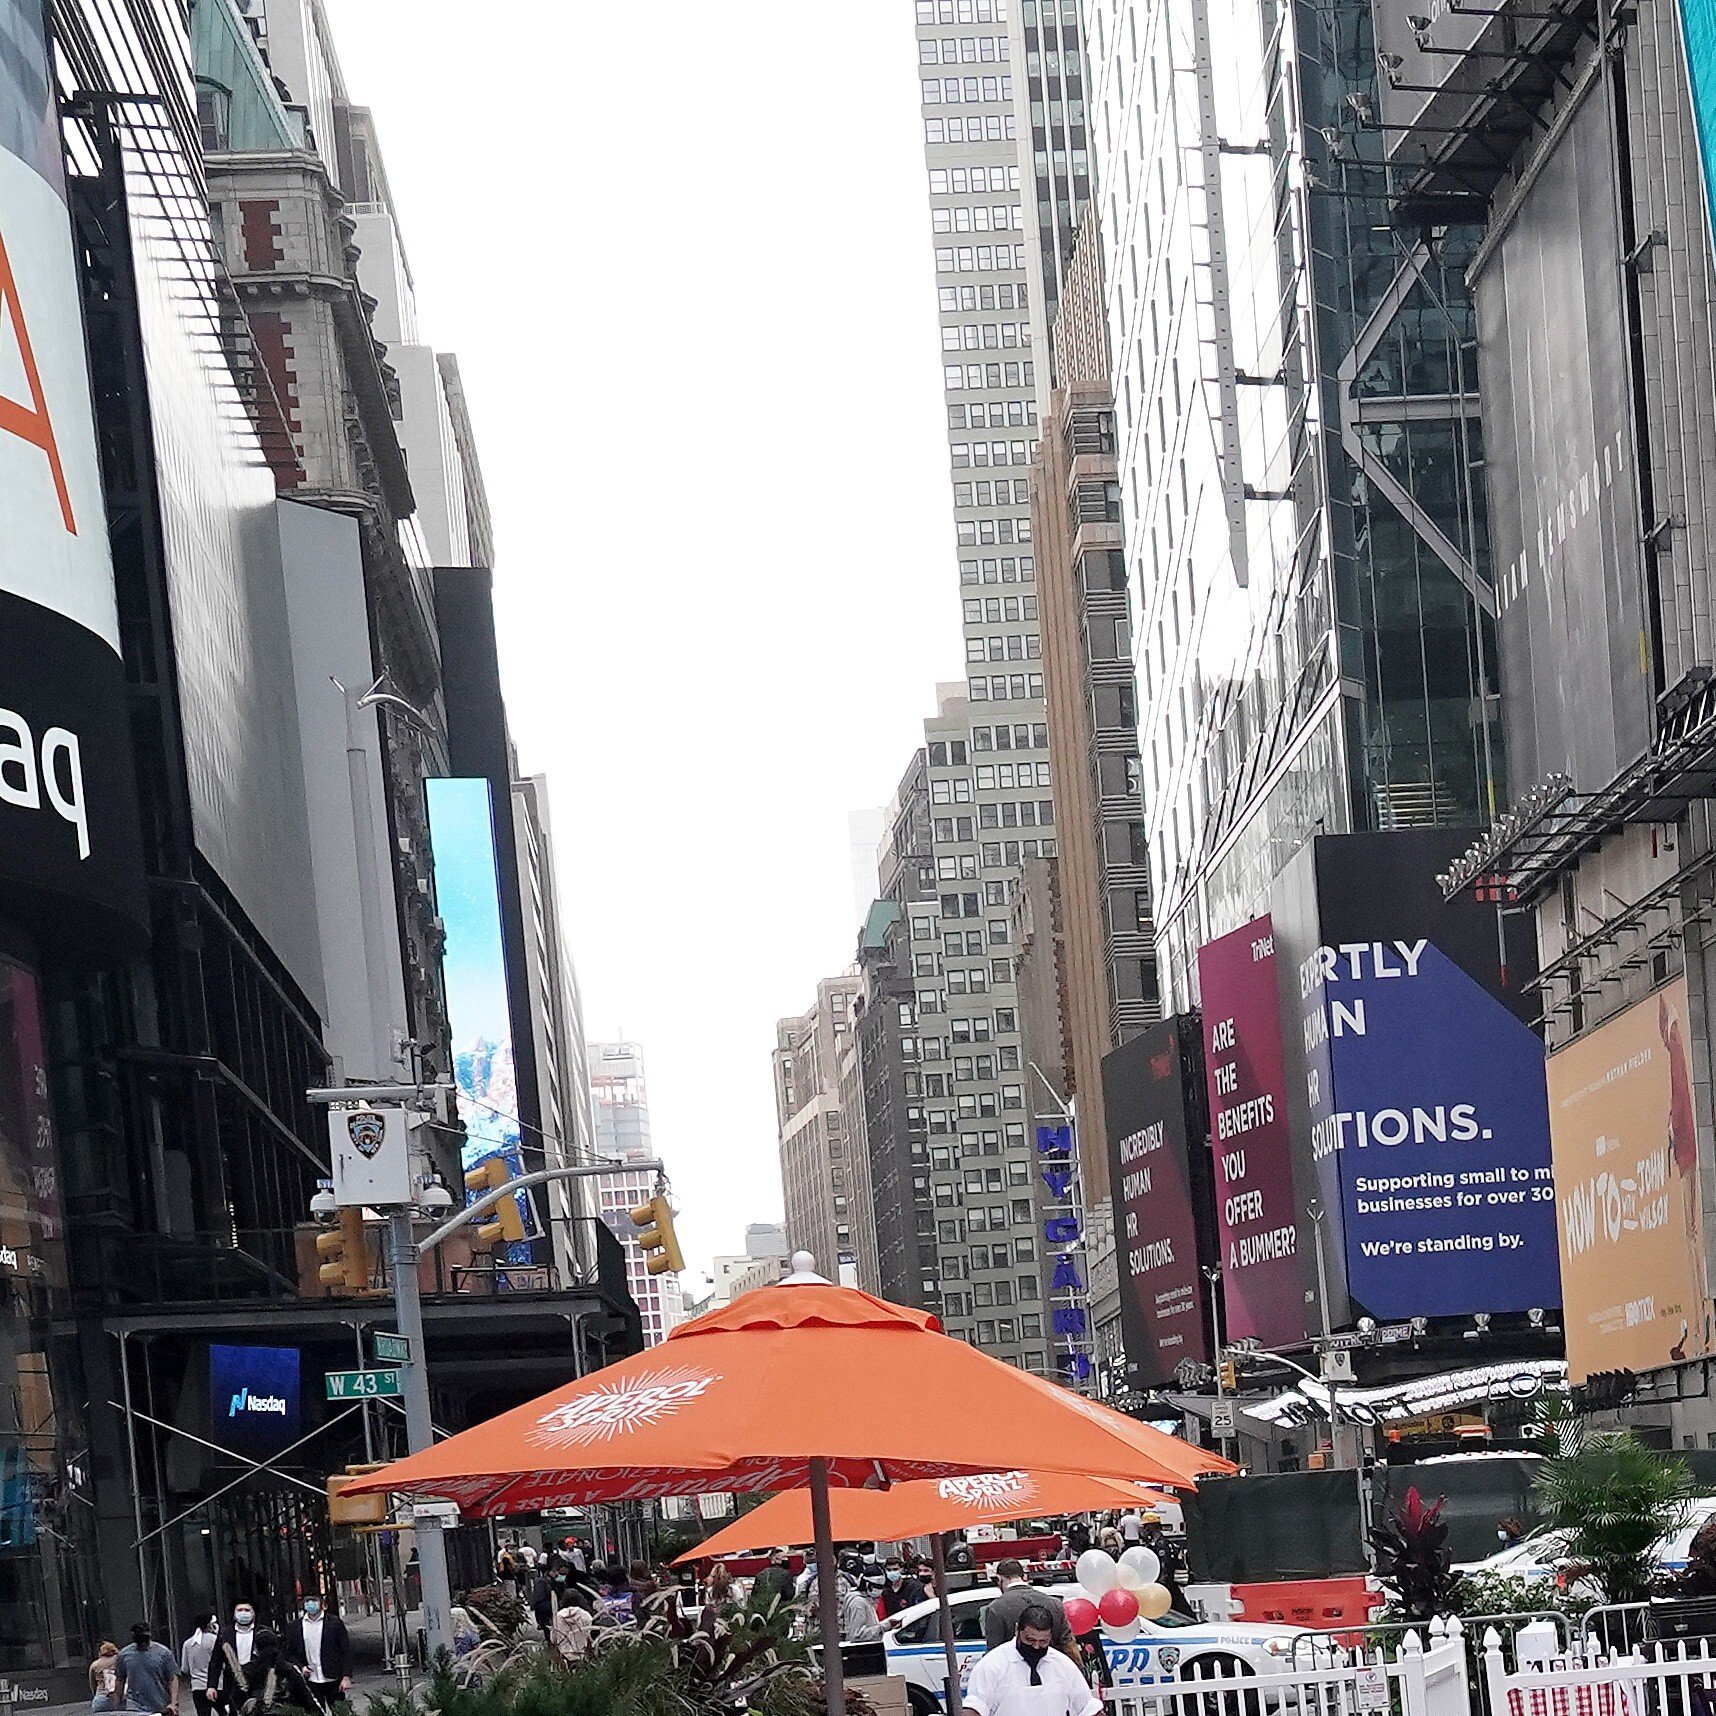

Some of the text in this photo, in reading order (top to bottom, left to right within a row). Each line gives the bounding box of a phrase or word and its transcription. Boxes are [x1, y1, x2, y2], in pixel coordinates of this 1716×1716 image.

[1300, 938, 1427, 999] EXPERTLY
[1212, 1018, 1235, 1054] ARE
[1303, 999, 1366, 1054] HUMAN
[1214, 1062, 1238, 1097] THE
[1307, 1068, 1320, 1108] HR
[1217, 1094, 1274, 1141] BENEFITS
[1311, 1104, 1493, 1162] SOLUTIONS.
[1119, 1120, 1165, 1165] INCREDIBLY
[1221, 1149, 1246, 1183] YOU
[1356, 1169, 1455, 1193] Supporting
[1459, 1166, 1505, 1185] small
[1510, 1166, 1529, 1182] to
[1636, 1147, 1665, 1199] JOHN
[1122, 1167, 1153, 1204] HUMAN
[1357, 1186, 1555, 1214] businesses for over 30
[1126, 1211, 1139, 1239] HR
[1225, 1189, 1264, 1228] OFFER
[1562, 1178, 1596, 1264] HOW
[1129, 1237, 1176, 1277] SOLUTIONS.
[1229, 1225, 1297, 1269] A BUMMER?
[1361, 1231, 1525, 1257] We're standing by.
[330, 1376, 345, 1396] W
[353, 1374, 378, 1394] 43
[536, 1376, 712, 1424] APEROL
[248, 1395, 286, 1415] Nasdaq
[1215, 1415, 1232, 1427] 25
[1218, 1636, 1250, 1645] POLICE
